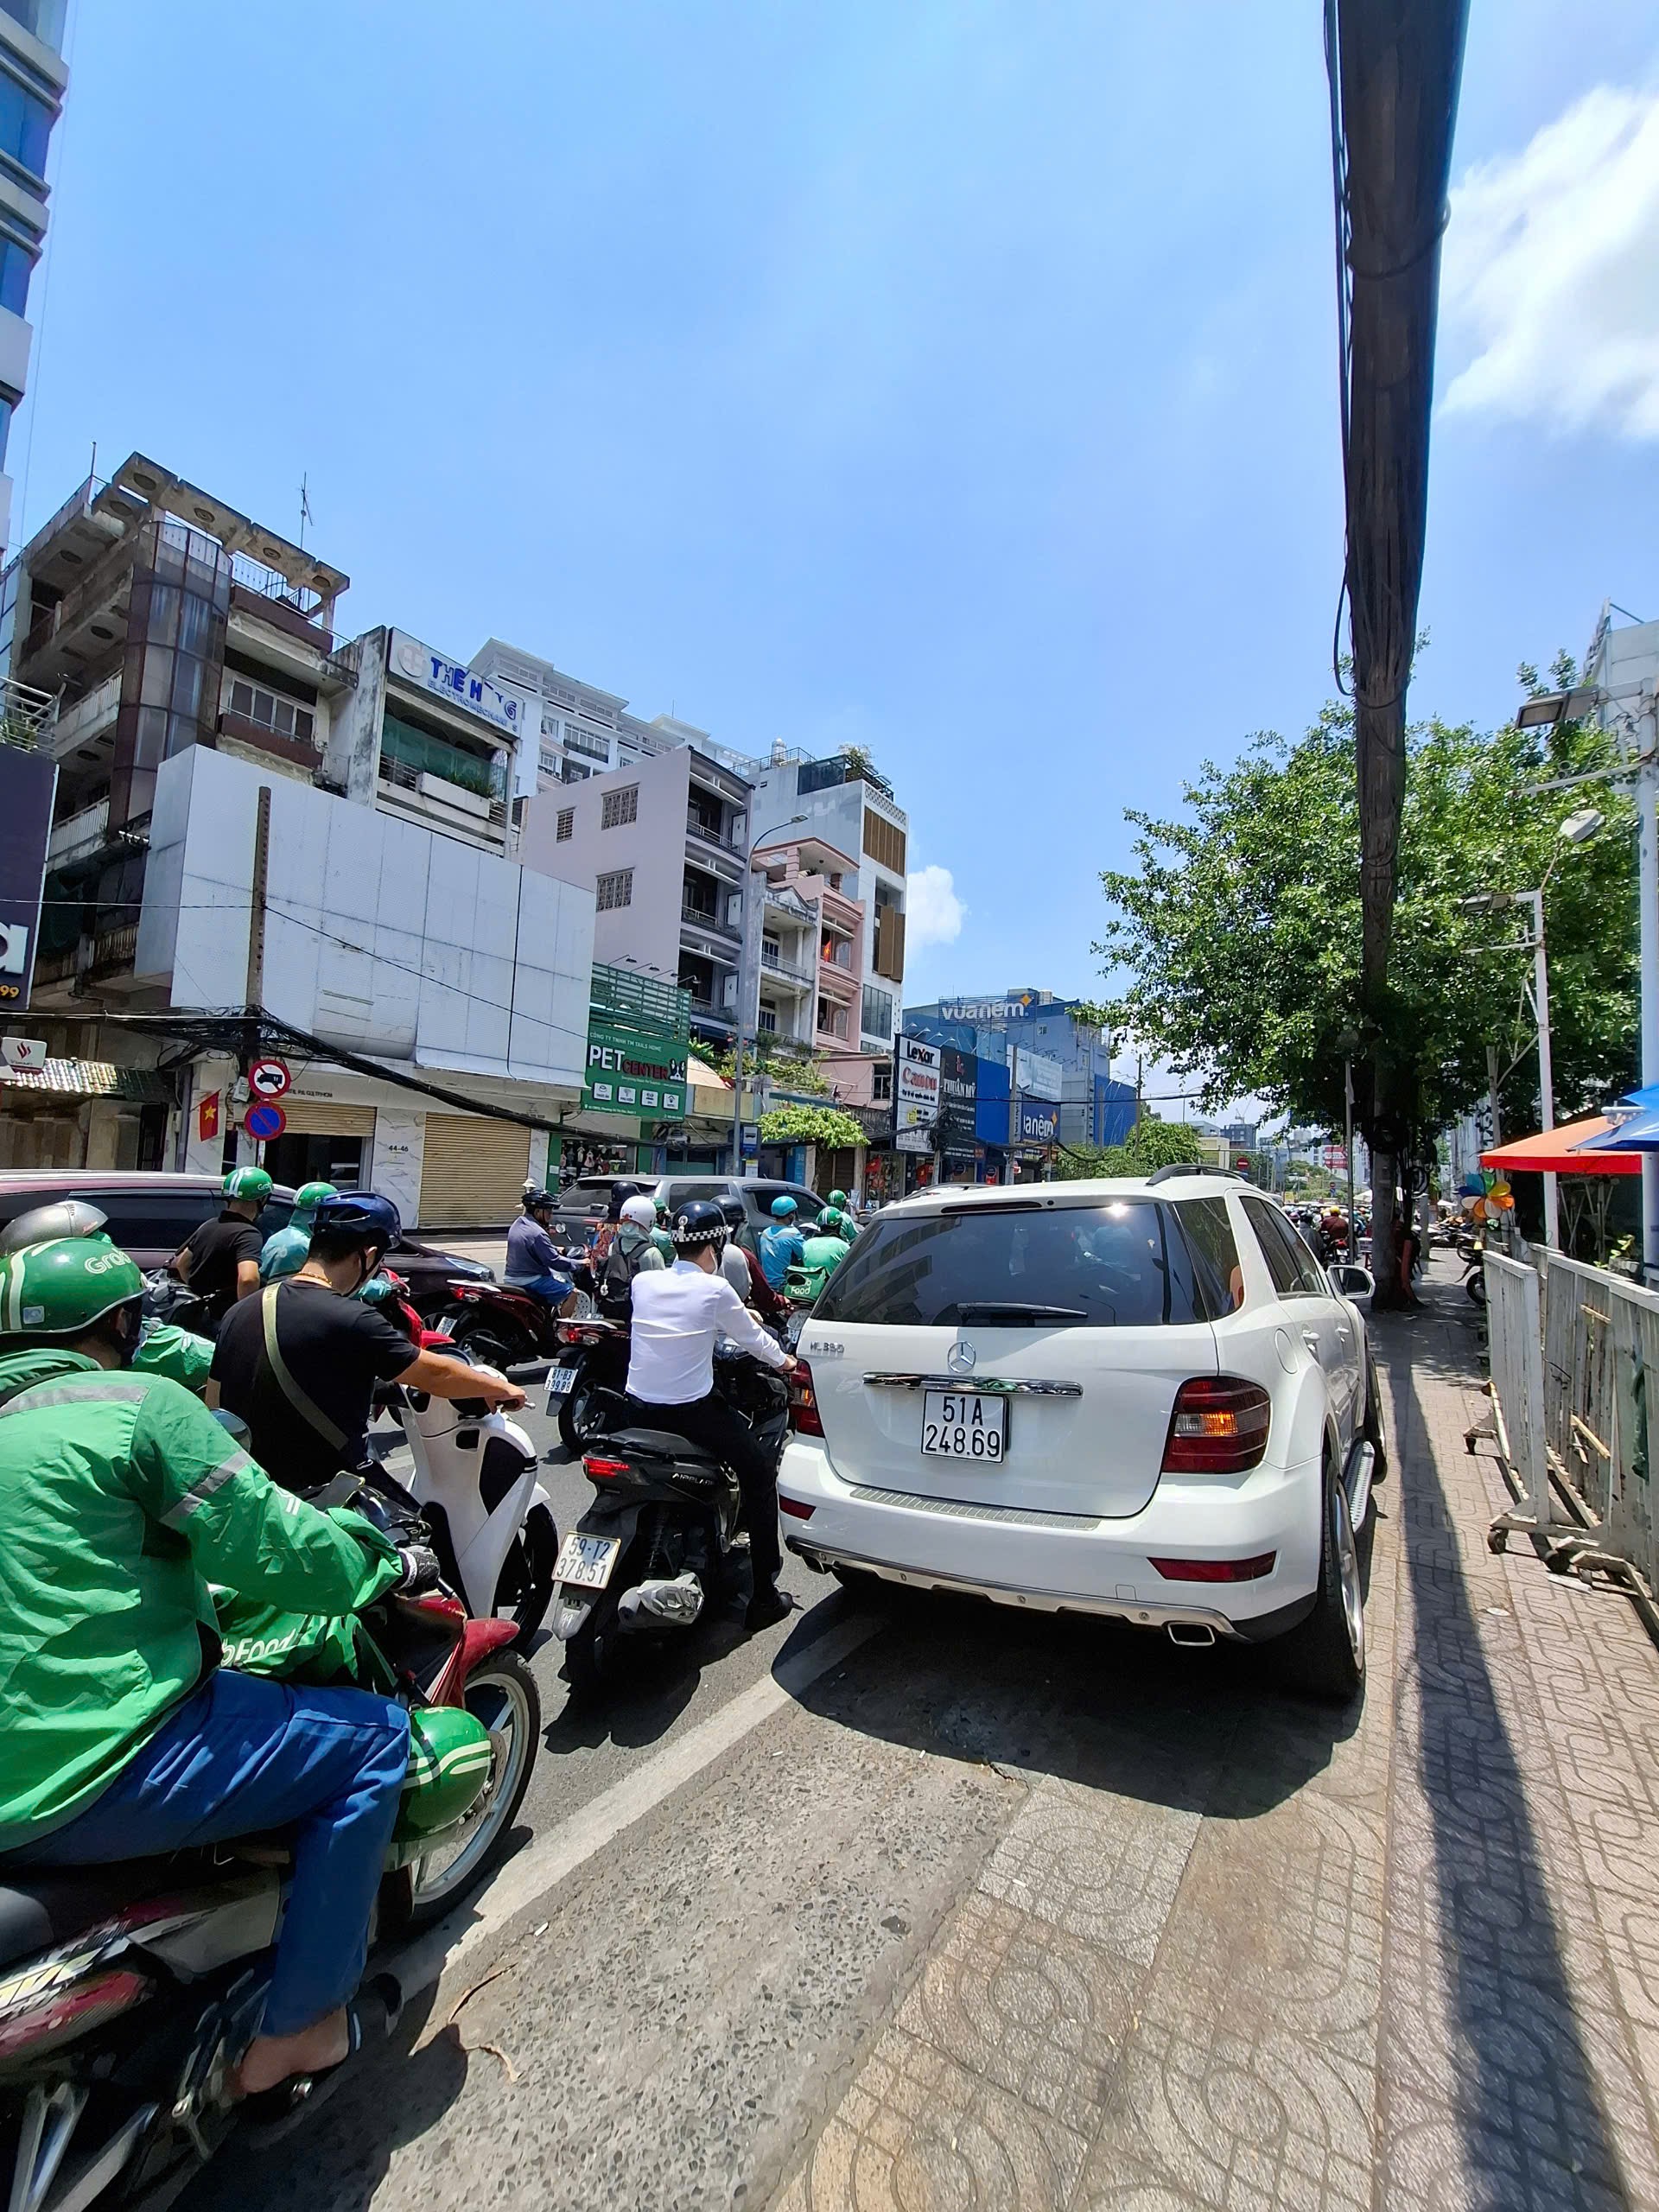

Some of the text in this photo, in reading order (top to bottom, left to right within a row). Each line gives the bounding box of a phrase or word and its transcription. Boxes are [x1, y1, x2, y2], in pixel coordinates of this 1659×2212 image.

[588, 1045, 668, 1080] PET CENTER
[906, 1040, 935, 1065] Lexar
[903, 1066, 938, 1091] Canon
[85, 1248, 132, 1274] Grab
[791, 1286, 811, 1295] Food
[943, 1395, 983, 1427] 51A
[925, 1424, 1001, 1458] 248.69
[556, 1558, 607, 1585] 378.51
